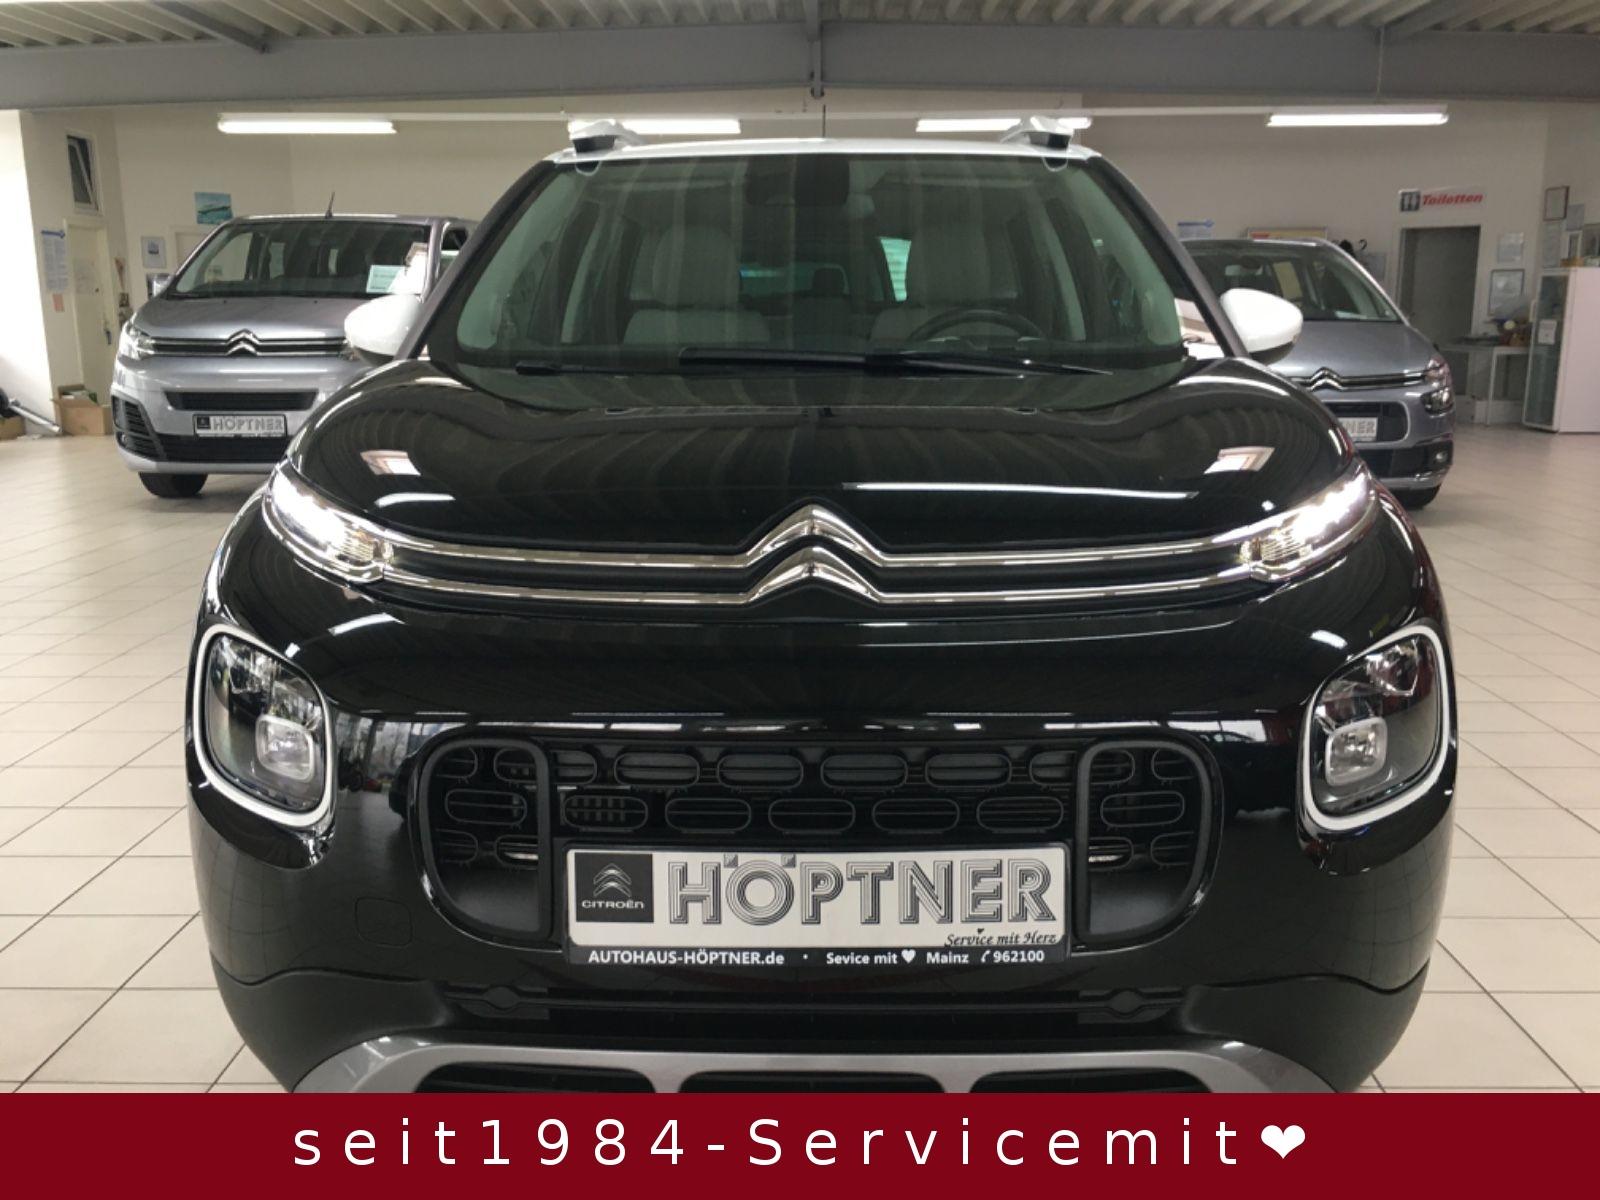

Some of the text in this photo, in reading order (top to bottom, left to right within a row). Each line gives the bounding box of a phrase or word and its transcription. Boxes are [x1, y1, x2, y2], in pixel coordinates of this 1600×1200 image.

[1422, 193, 1484, 207] Toiletten
[668, 853, 1057, 925] HÖPTNER
[944, 930, 1058, 948] Service mit Herz
[588, 948, 1045, 965] AUTOHAUS-HÖPTNER.de Sevice mit Mainz 962100
